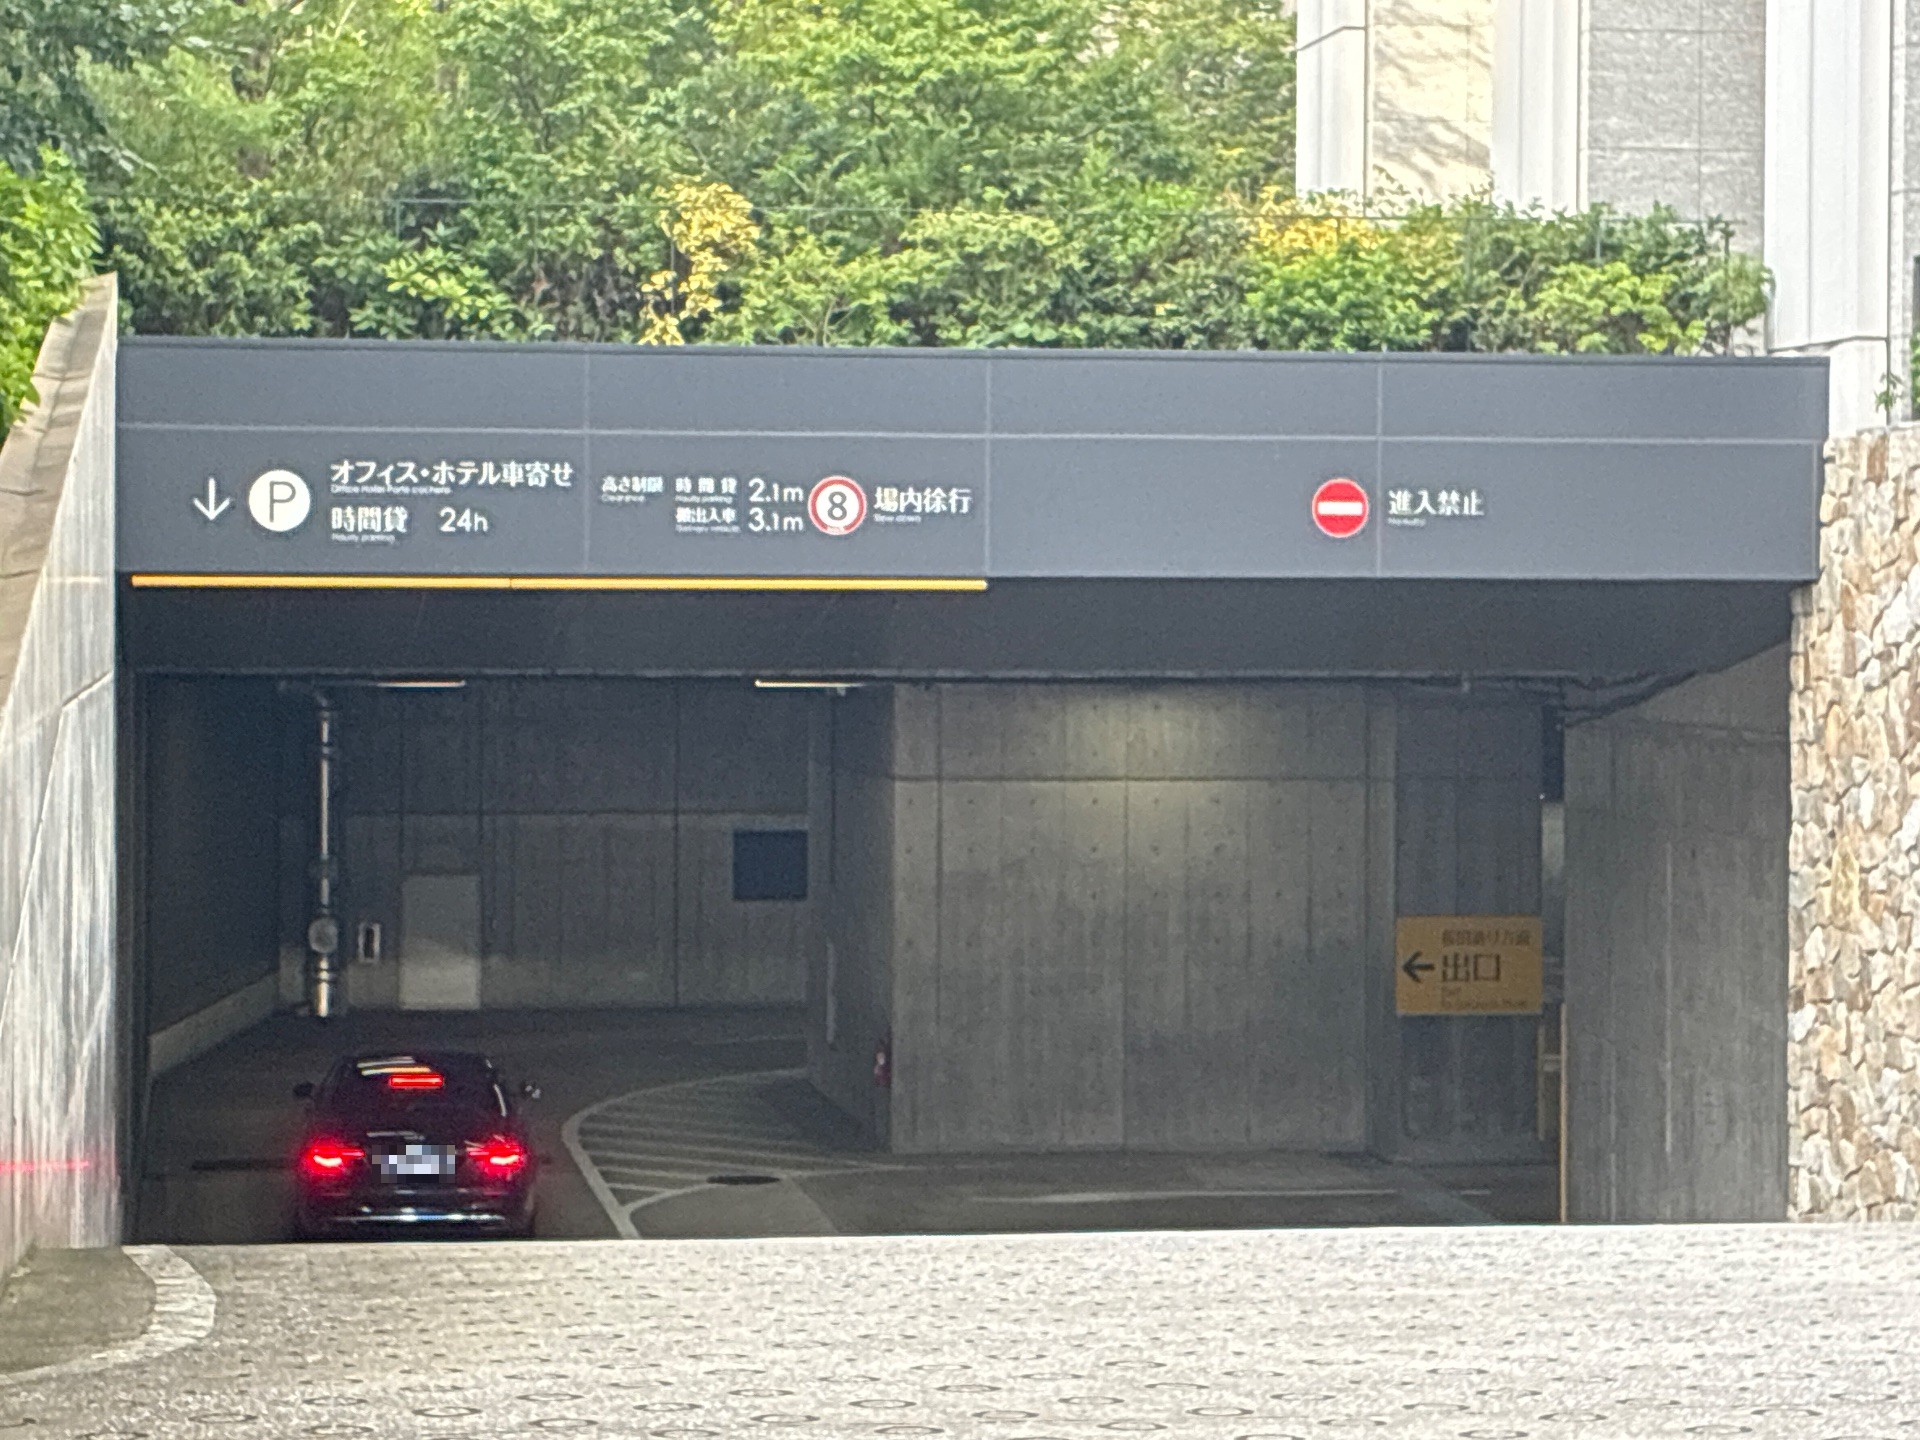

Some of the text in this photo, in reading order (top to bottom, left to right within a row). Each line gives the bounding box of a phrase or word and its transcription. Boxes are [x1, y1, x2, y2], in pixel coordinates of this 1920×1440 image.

[330, 460, 574, 488] オフィス・ホテル車寄せ
[269, 480, 297, 523] P
[748, 477, 804, 502] 2.1m
[873, 486, 973, 514] 場内徐行
[1388, 488, 1485, 516] 進入禁止
[331, 506, 489, 533] 時間貸 24h
[748, 507, 804, 532] 3.1m
[827, 491, 848, 521] 8
[1442, 952, 1501, 983] 出口
